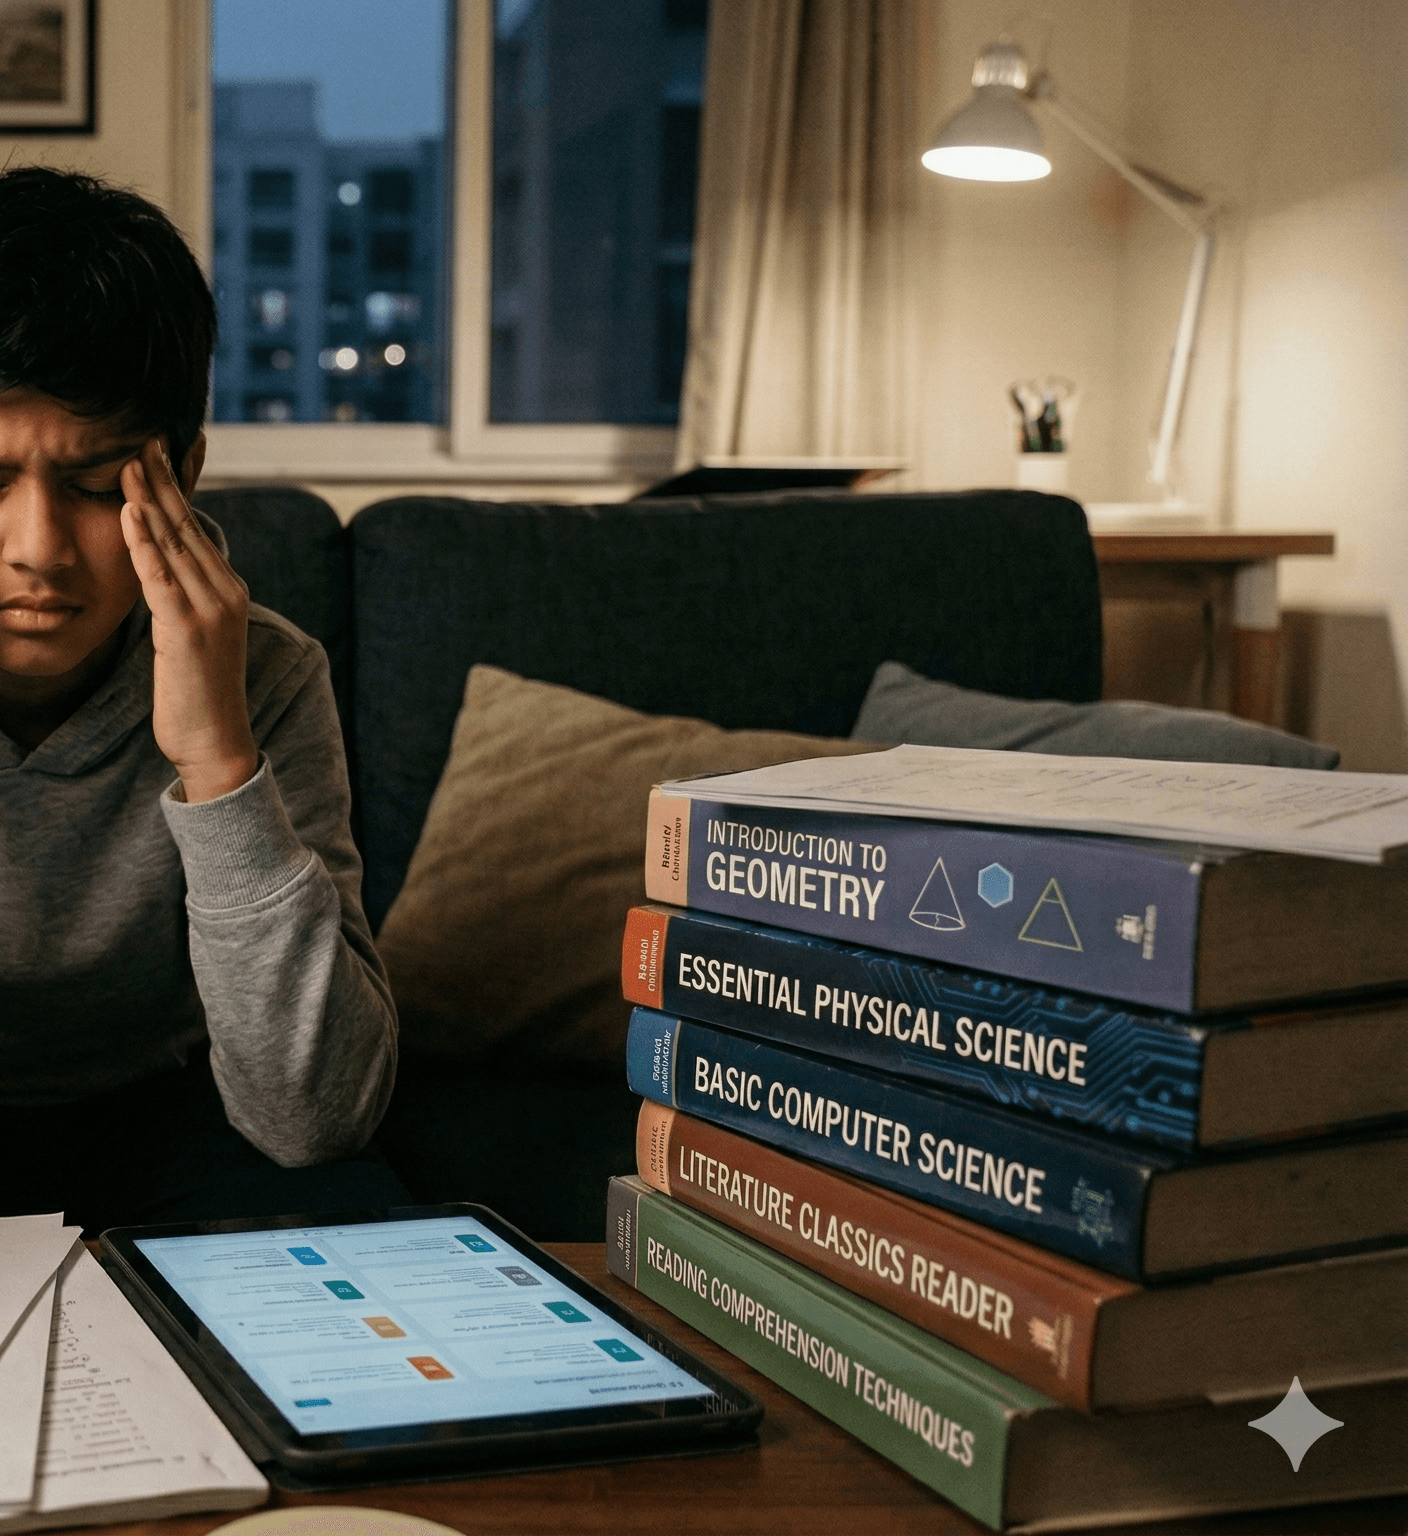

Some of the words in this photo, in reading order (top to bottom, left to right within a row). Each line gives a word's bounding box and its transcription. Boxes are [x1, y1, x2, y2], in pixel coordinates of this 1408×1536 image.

[706, 851, 885, 921] GEOMETRY
[707, 819, 853, 867] INTRODUCTION
[859, 843, 887, 873] TO
[678, 952, 807, 1016] ESSENTIAL
[814, 984, 947, 1051] PHYSICAL
[954, 1016, 1088, 1086] SCIENCE
[694, 1056, 762, 1111] BASIC
[768, 1081, 911, 1166] COMPUTER
[917, 1132, 1045, 1214] SCIENCE
[679, 1145, 794, 1231] LITERATURE
[799, 1202, 905, 1285] CLASSICS
[910, 1253, 1014, 1339] READER
[647, 1236, 708, 1299] READING
[711, 1277, 849, 1387] COMPREHENSION
[853, 1361, 975, 1467] TECHNIQUES
